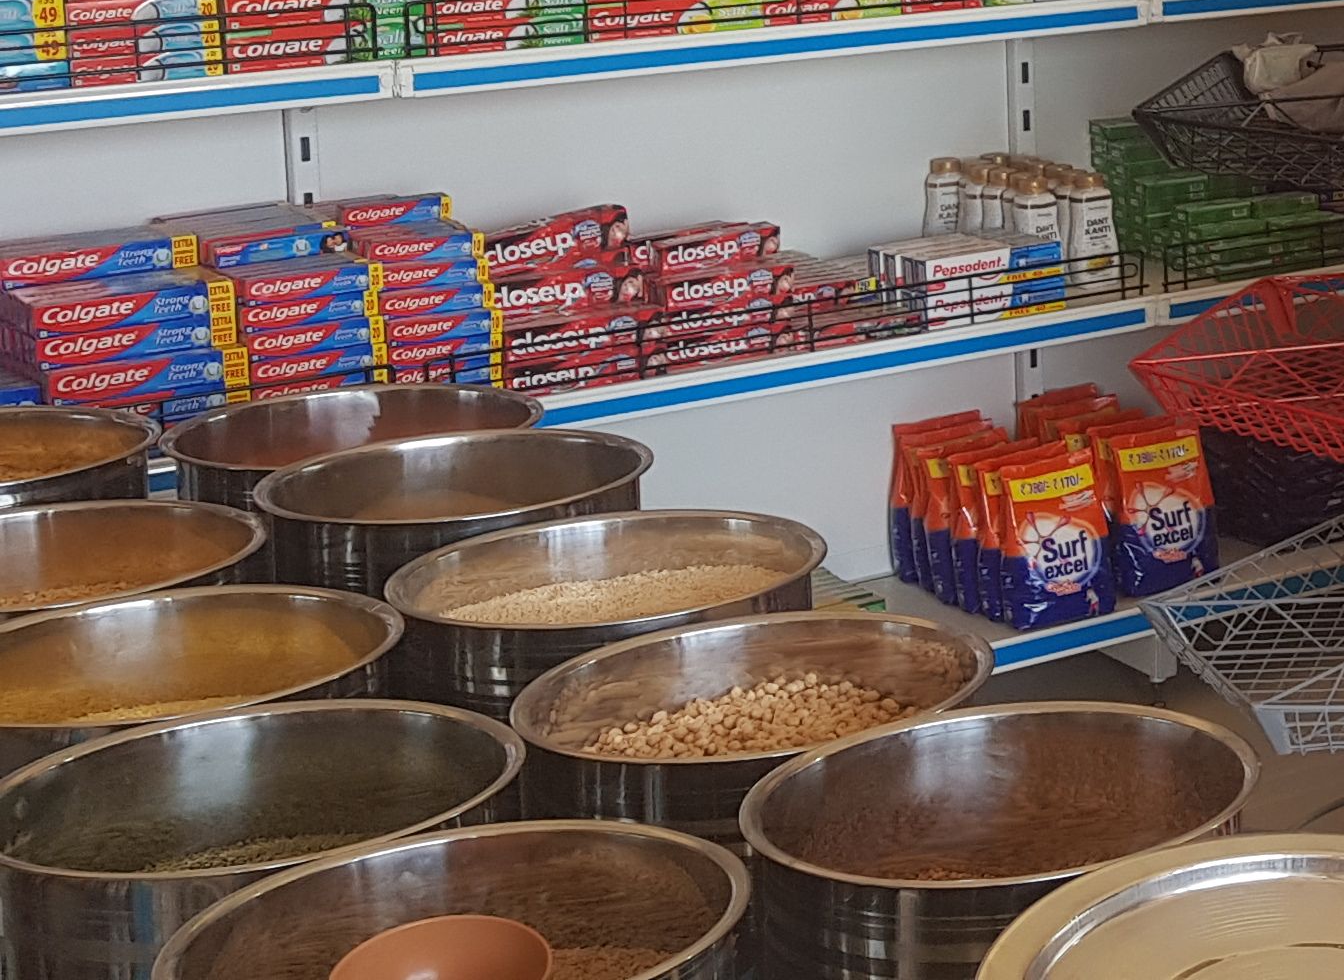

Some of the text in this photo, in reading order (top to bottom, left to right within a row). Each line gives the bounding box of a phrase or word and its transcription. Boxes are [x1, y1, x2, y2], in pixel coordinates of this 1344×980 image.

[1087, 217, 1109, 226] DANT
[1085, 226, 1111, 235] KANTI
[173, 237, 194, 249] EXTRA
[486, 231, 576, 267] closeup
[666, 238, 740, 267] closeup
[8, 248, 154, 278] Colgate Strong
[118, 254, 149, 267] Teeth
[173, 254, 195, 267] FREE
[933, 257, 1002, 277] Pepsodent
[209, 284, 232, 297] EXTRA
[492, 275, 585, 308] closeup
[672, 276, 745, 303] closeup
[42, 293, 190, 326] Colgate Strong
[156, 302, 184, 315] Teeth
[211, 301, 233, 313] FREE
[211, 317, 233, 330] EXTRA
[43, 325, 192, 357] Colgate Strong
[157, 332, 185, 346] Teeth
[212, 331, 234, 343] FREE
[225, 351, 246, 363] EXTRA
[57, 361, 202, 394] Colgate Strong
[168, 368, 196, 383] Teeth
[225, 366, 246, 379] FREE
[1150, 501, 1191, 531] Surf
[1153, 525, 1193, 547] excel
[1041, 530, 1087, 563] Surf
[1045, 557, 1088, 580] excel
